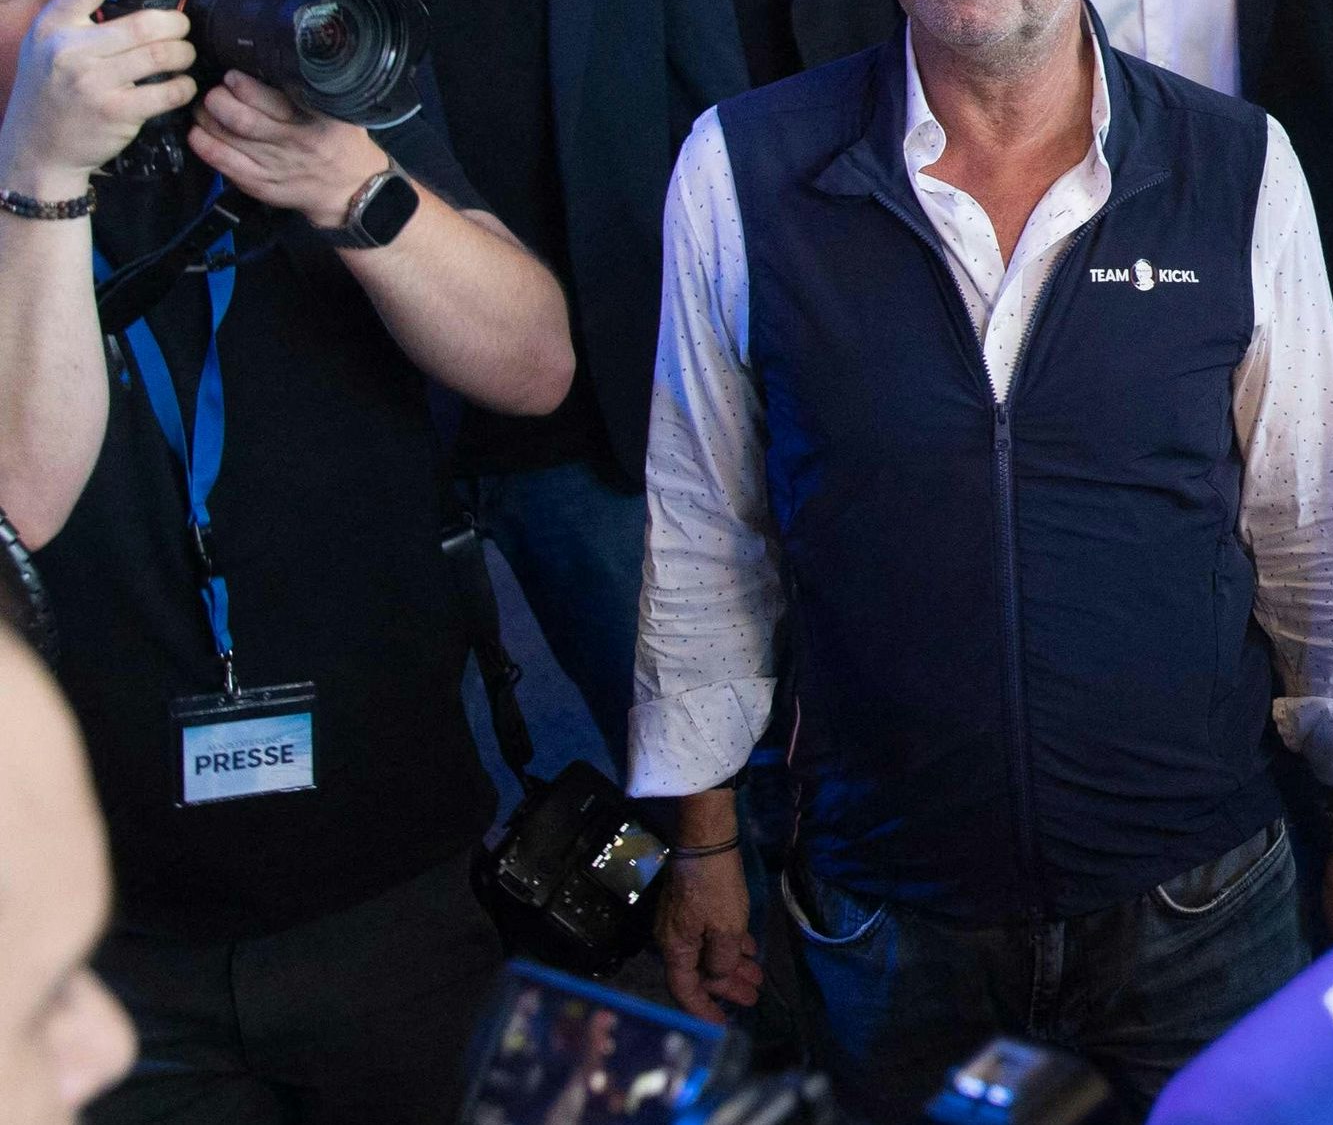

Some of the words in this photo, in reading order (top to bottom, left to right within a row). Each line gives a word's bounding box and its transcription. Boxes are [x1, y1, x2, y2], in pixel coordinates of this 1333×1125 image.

[1090, 268, 1129, 283] TEAM
[1159, 268, 1200, 283] KICKL
[195, 744, 294, 775] PRESSE
